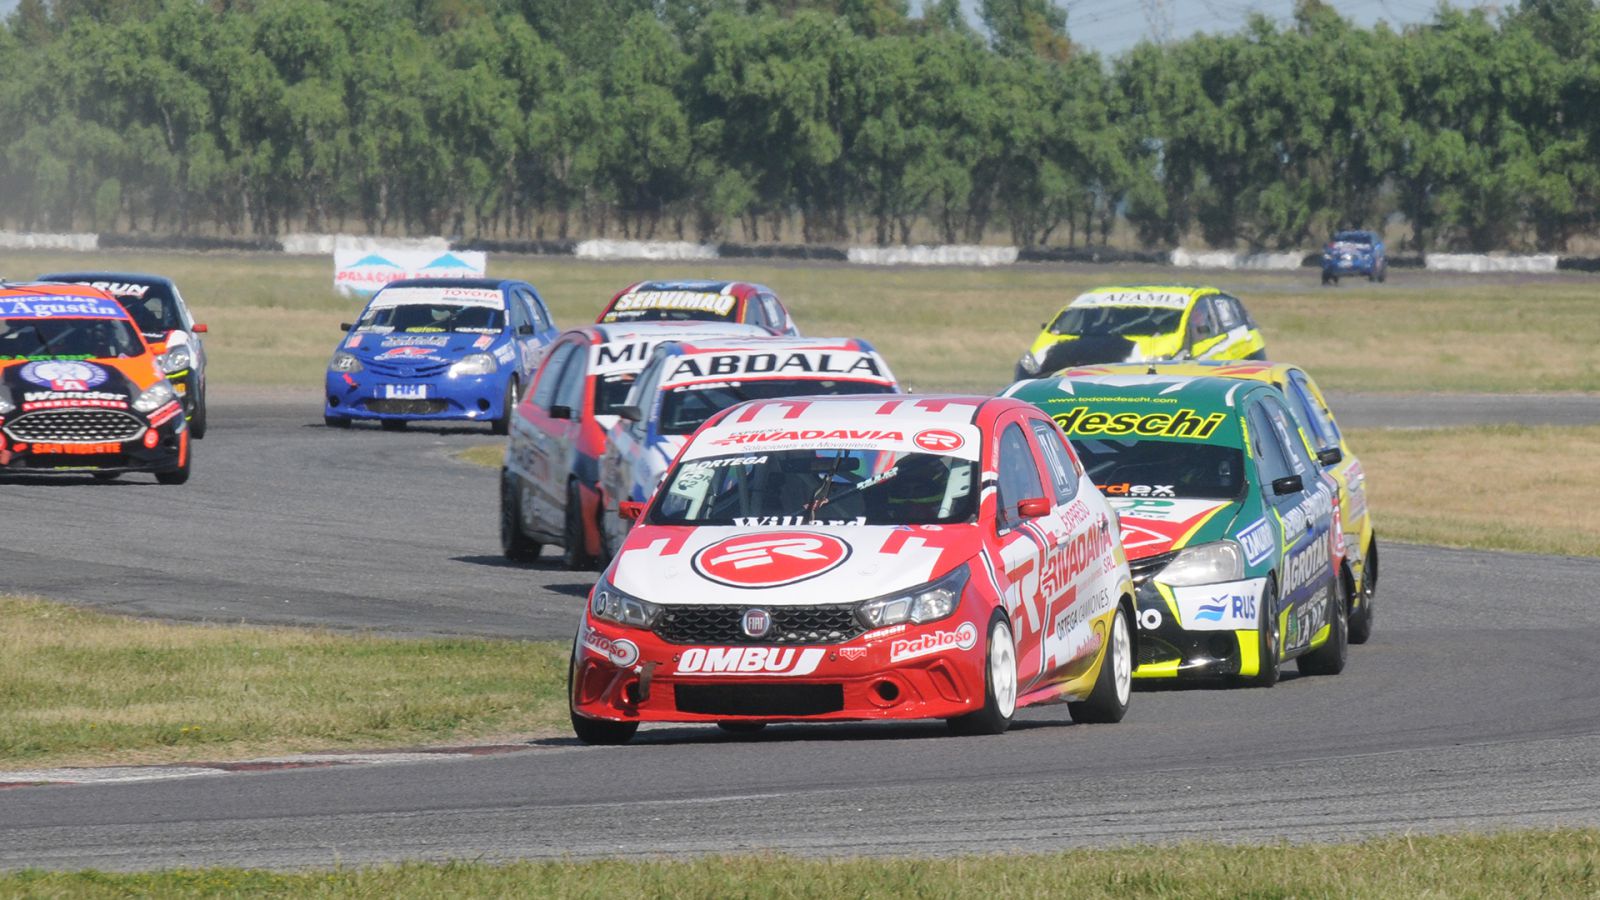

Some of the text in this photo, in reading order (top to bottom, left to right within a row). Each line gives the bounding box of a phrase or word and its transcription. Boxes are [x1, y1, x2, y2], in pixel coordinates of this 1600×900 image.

[442, 288, 499, 299] TOYOTA
[10, 302, 118, 317] Agustin
[614, 290, 737, 316] SERVIMAQ
[666, 352, 882, 382] ABDALA
[24, 391, 128, 402] Wander
[1048, 396, 1178, 404] www.todotedeschi.com
[712, 430, 905, 445] RIVADAVIA
[732, 516, 867, 527] Willard
[1042, 512, 1113, 598] RIVADAVIA
[1232, 595, 1256, 619] RUS
[748, 616, 764, 630] FIAT
[892, 630, 971, 657] Pabloso
[677, 647, 797, 672] OMBU
